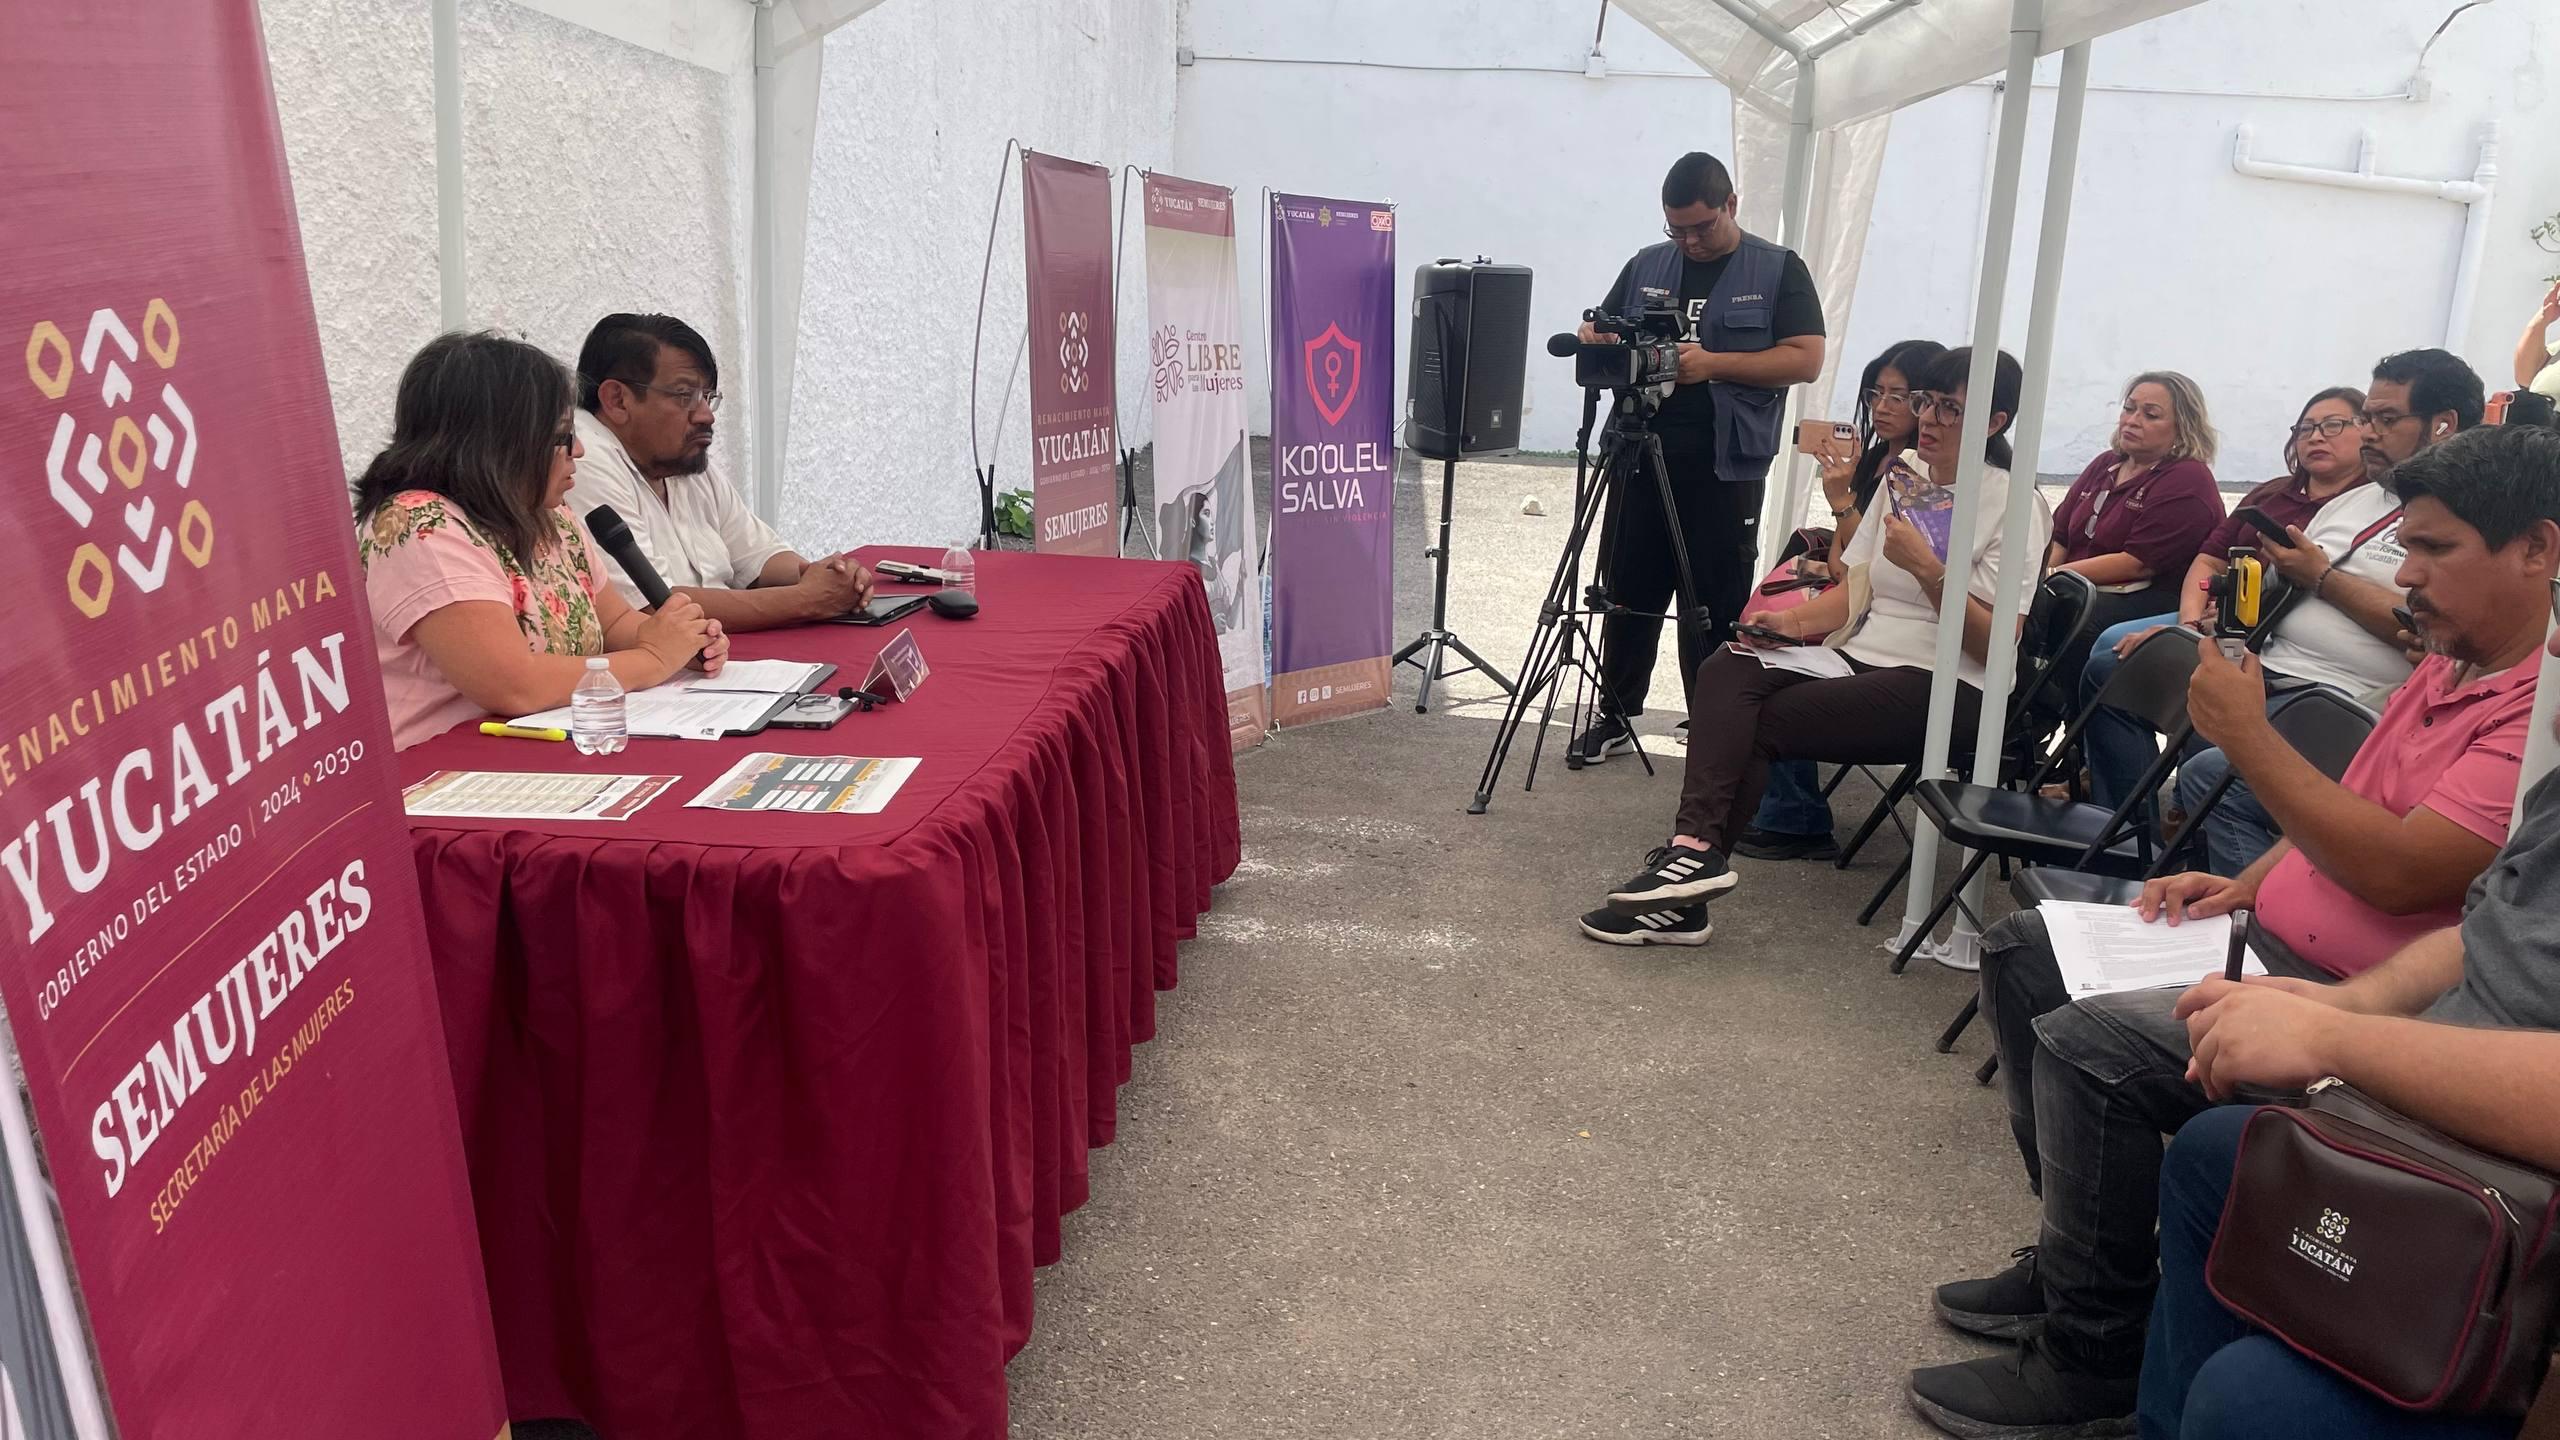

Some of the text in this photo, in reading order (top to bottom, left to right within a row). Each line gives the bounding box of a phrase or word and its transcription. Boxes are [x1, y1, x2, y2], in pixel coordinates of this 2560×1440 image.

[1731, 294, 1764, 304] PRENSA
[1187, 343, 1242, 371] LIBRE
[1200, 372, 1243, 396] Mujeres
[1038, 423, 1110, 466] YUCATÁN
[1282, 478, 1364, 514] SALVA
[1044, 501, 1108, 543] SEMUJERES
[0, 570, 338, 797] ENACIMIENTO MAYA
[1, 631, 352, 944] YUCATÁN
[37, 740, 364, 1021] GOBIERNO DEL ESTADO 2024 2030
[90, 858, 372, 1199] SEMUJERES
[150, 978, 355, 1235] SECRETARÍA DE LAS MUJERES
[2291, 1233, 2355, 1276] YUCATÁN
